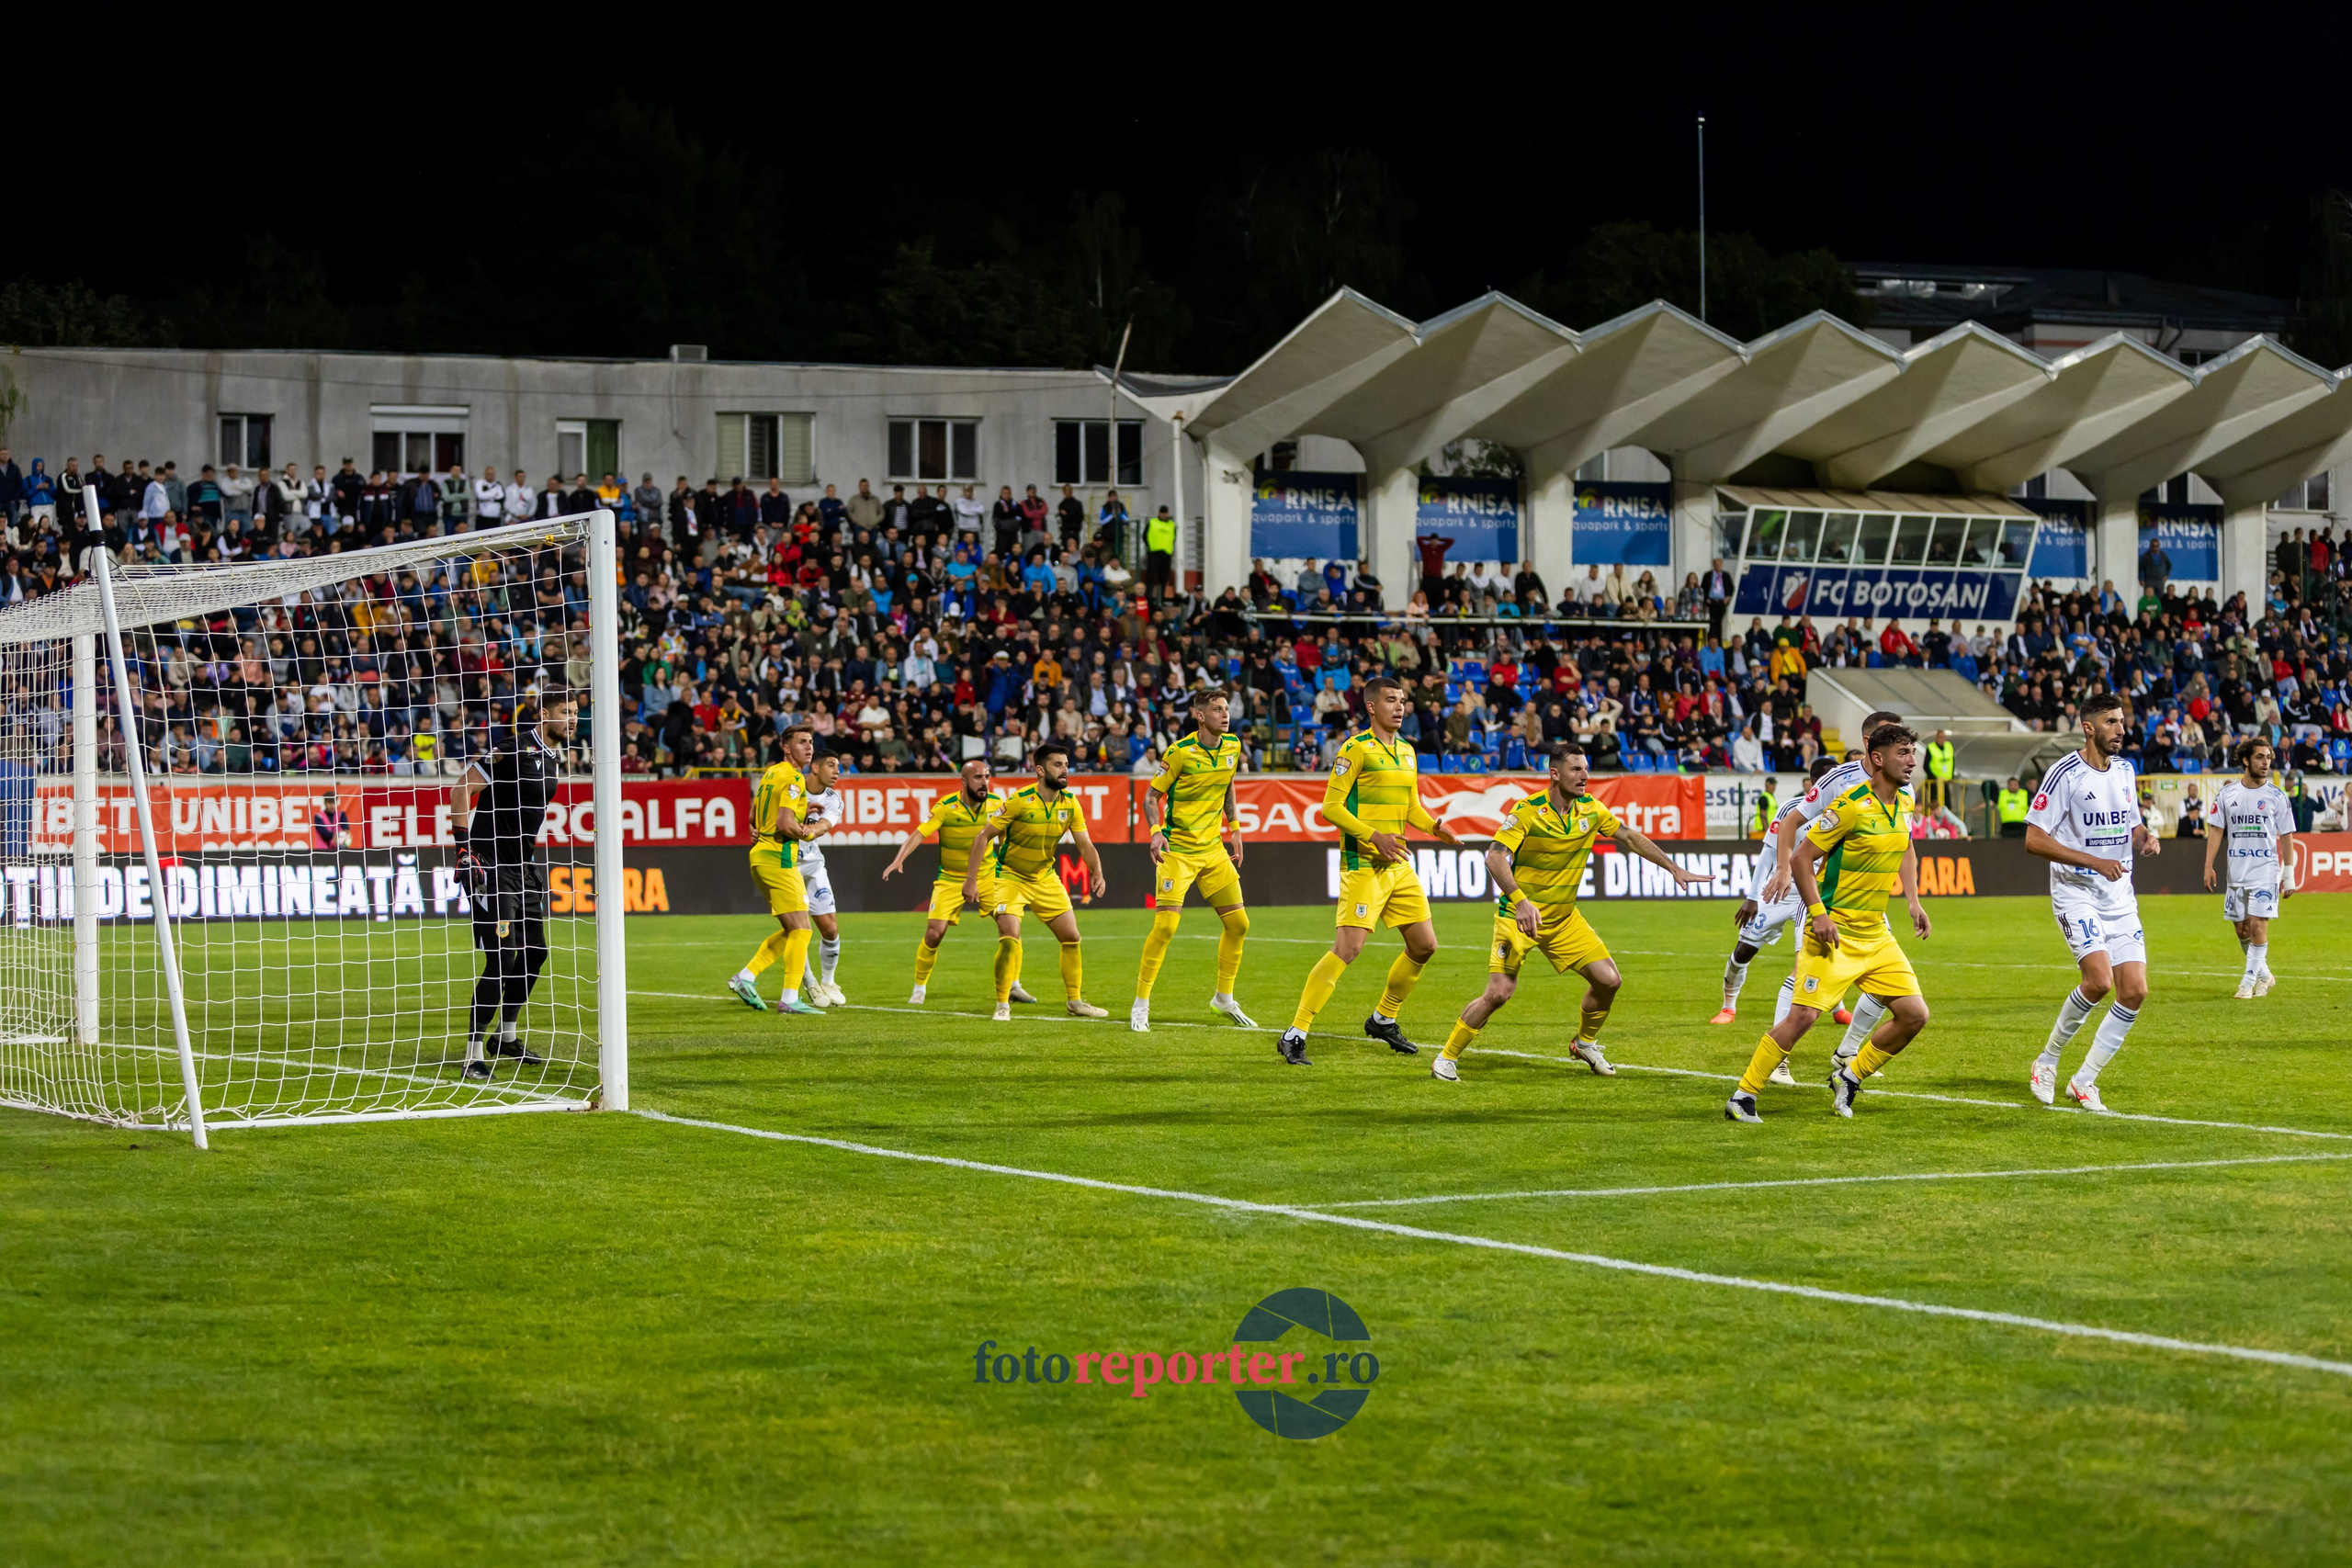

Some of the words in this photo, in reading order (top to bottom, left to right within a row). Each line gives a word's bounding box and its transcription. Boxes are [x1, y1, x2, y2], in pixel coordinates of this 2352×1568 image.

[1320, 514, 1356, 525] sports
[1482, 517, 1516, 529] sports
[1634, 521, 1668, 532] sports
[1814, 580, 1849, 605] FC
[2083, 810, 2131, 827] UNIBE
[2231, 814, 2268, 825] UNIBET
[2228, 849, 2273, 858] ELSACO
[549, 866, 670, 913] SERA
[2078, 919, 2100, 939] 16
